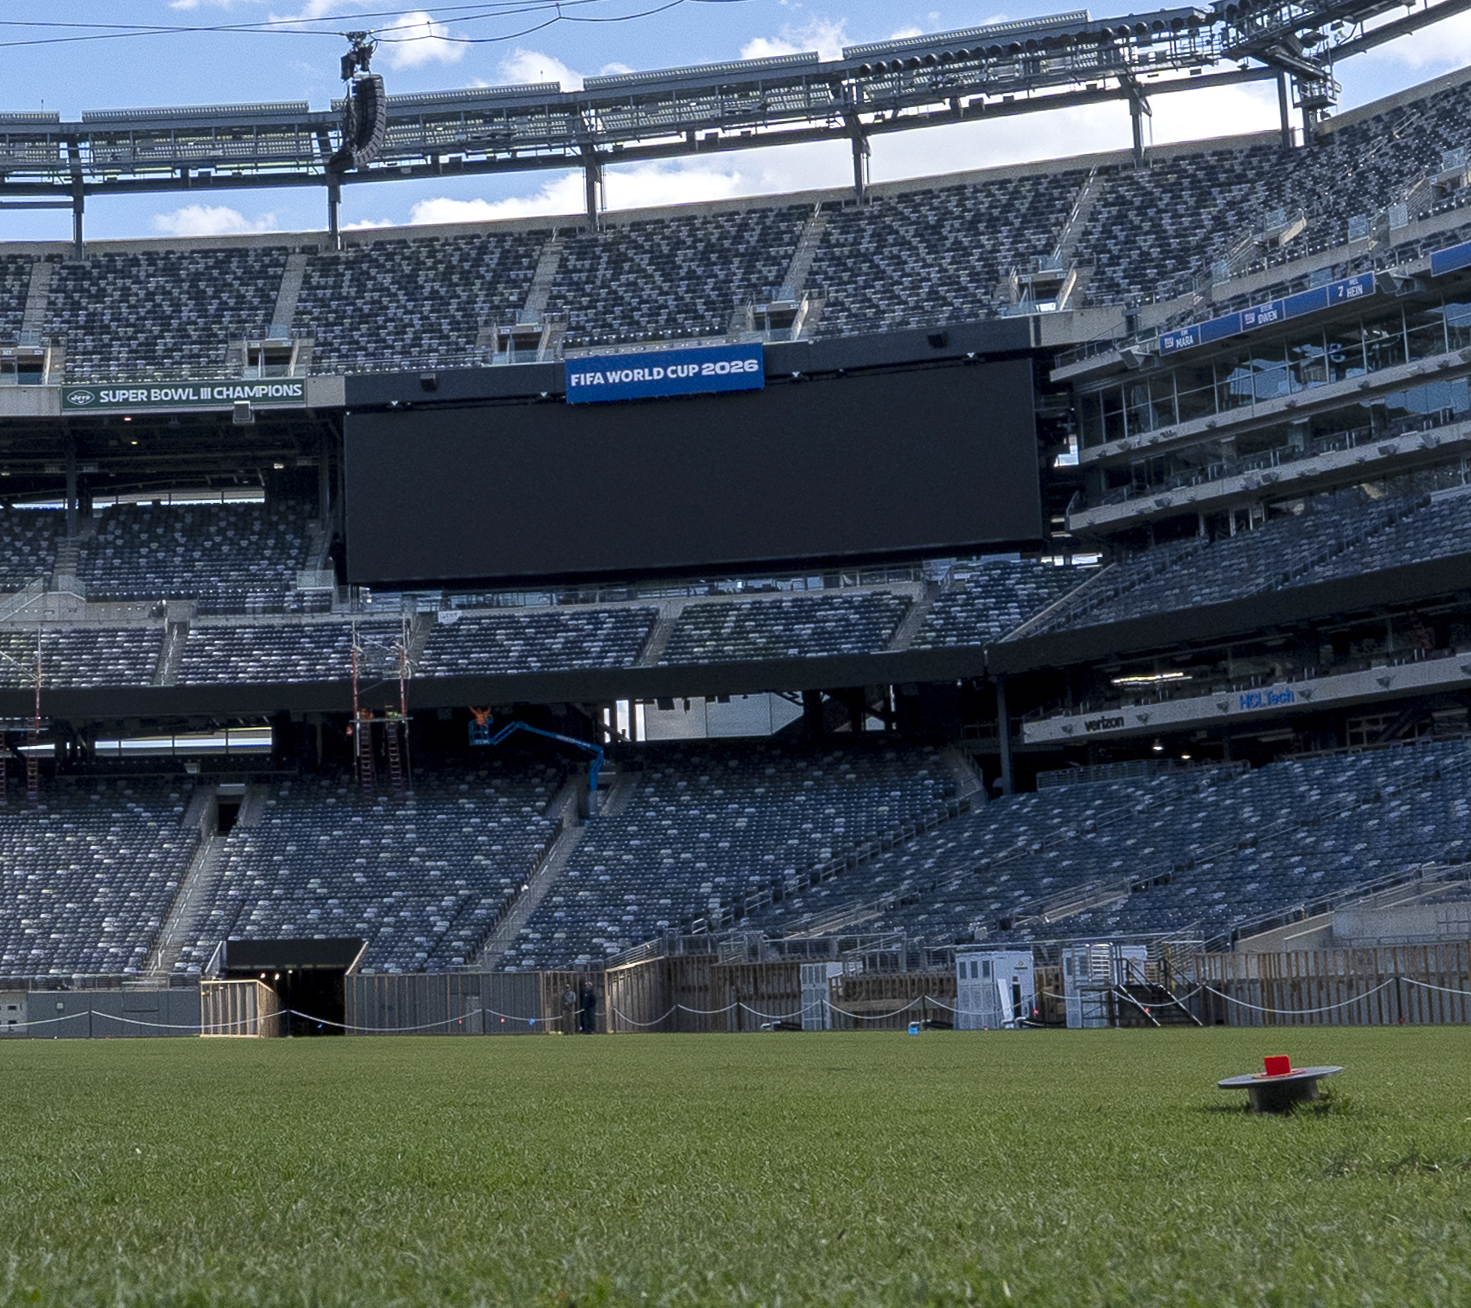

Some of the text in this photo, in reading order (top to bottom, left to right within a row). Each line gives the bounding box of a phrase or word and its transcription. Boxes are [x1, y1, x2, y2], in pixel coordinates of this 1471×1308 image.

[1338, 284, 1363, 298] 7 HEIN
[1258, 310, 1277, 324] OWEN
[1176, 335, 1194, 348] MARA
[570, 359, 759, 386] FIFA WORLD CUP 2026
[100, 390, 148, 403] SUPER
[151, 388, 198, 401] BOWL
[200, 387, 211, 399] III
[213, 384, 302, 399] CHAMPIONS
[1239, 690, 1295, 710] HCLTech
[1084, 716, 1124, 732] verizon
